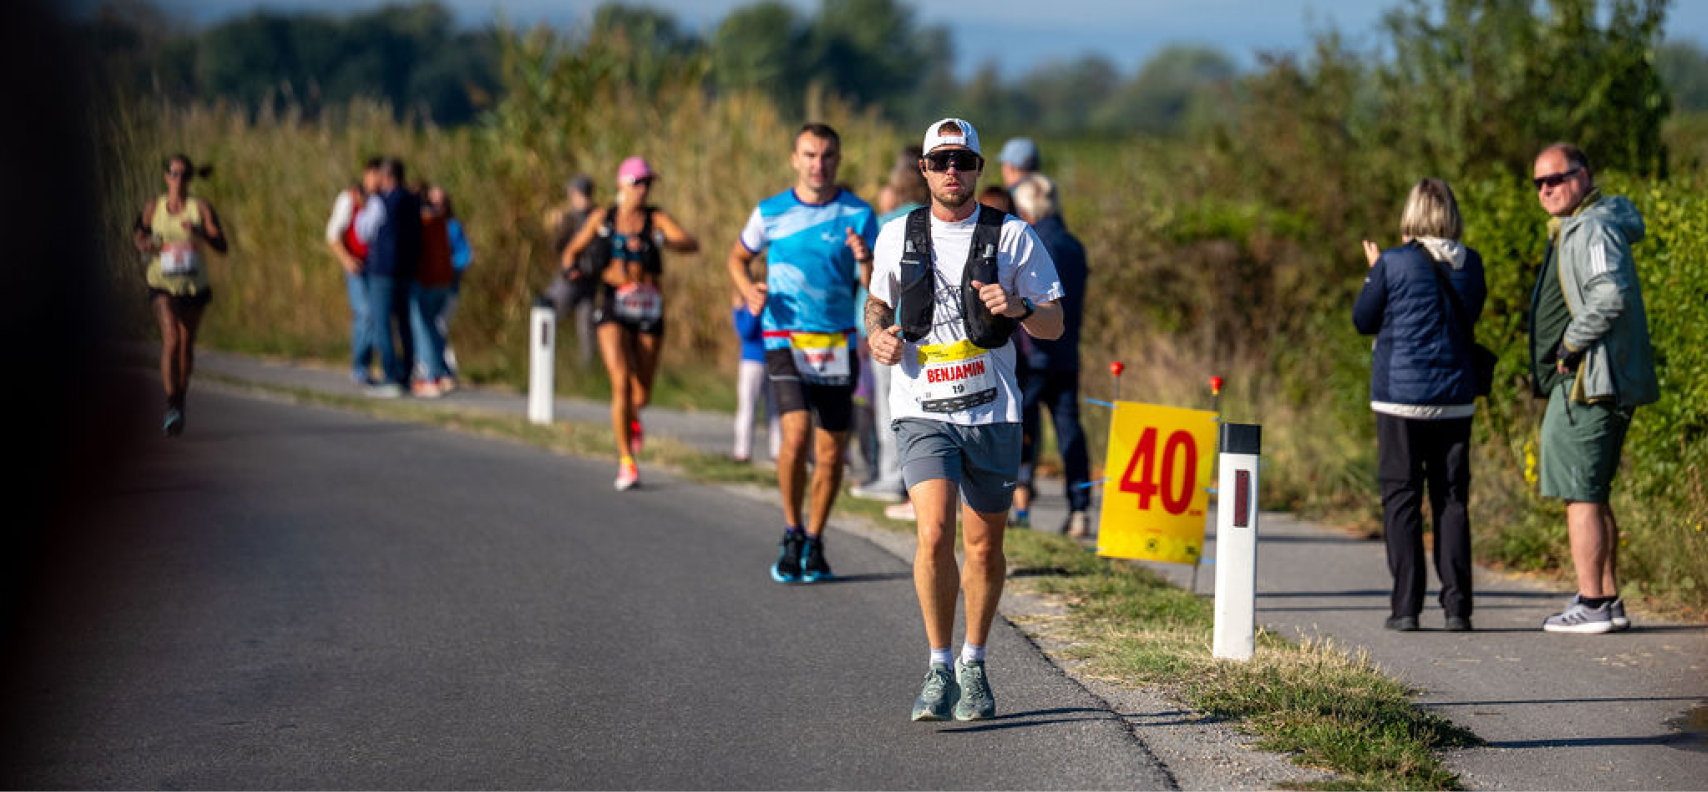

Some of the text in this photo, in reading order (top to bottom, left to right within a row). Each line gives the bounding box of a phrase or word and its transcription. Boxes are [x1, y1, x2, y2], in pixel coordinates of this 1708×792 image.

[927, 360, 985, 383] BENJAMIN
[952, 383, 965, 394] 19
[1119, 427, 1198, 515] 40
